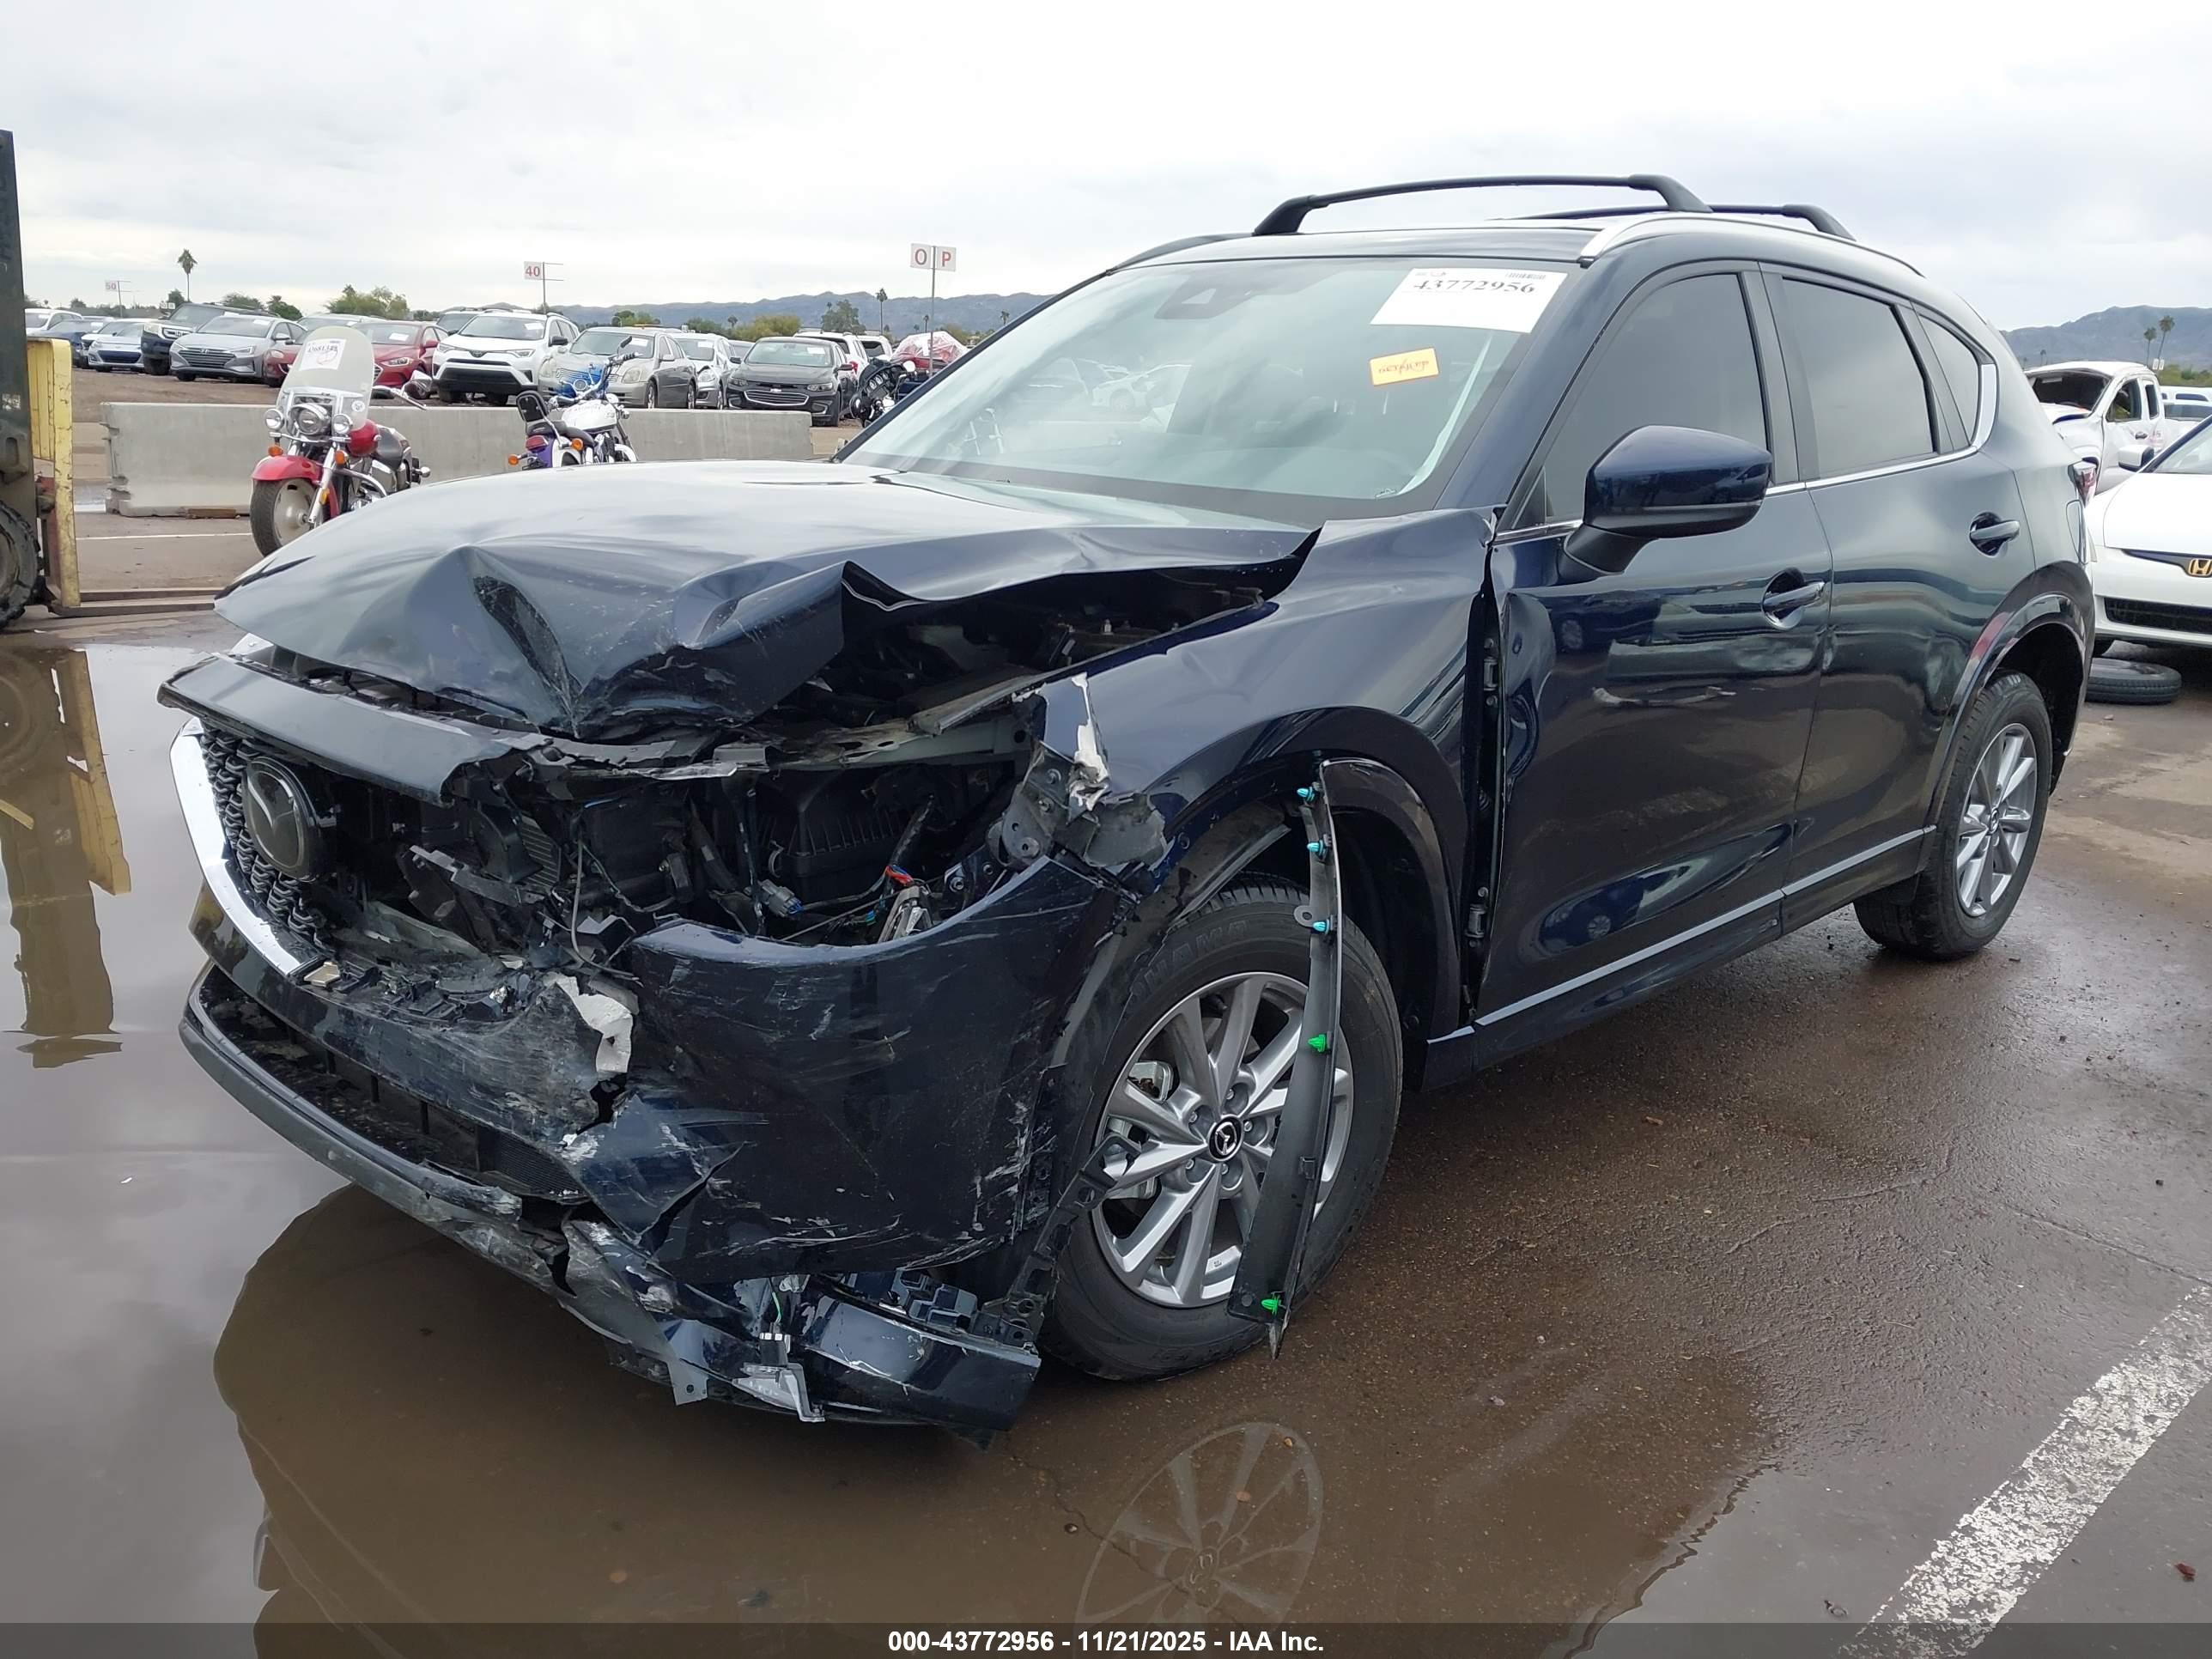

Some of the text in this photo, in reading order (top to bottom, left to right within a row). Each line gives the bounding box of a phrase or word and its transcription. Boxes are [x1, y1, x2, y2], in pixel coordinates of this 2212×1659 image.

[915, 248, 951, 267] O P
[525, 265, 541, 276] 40
[1413, 279, 1535, 294] 43772956
